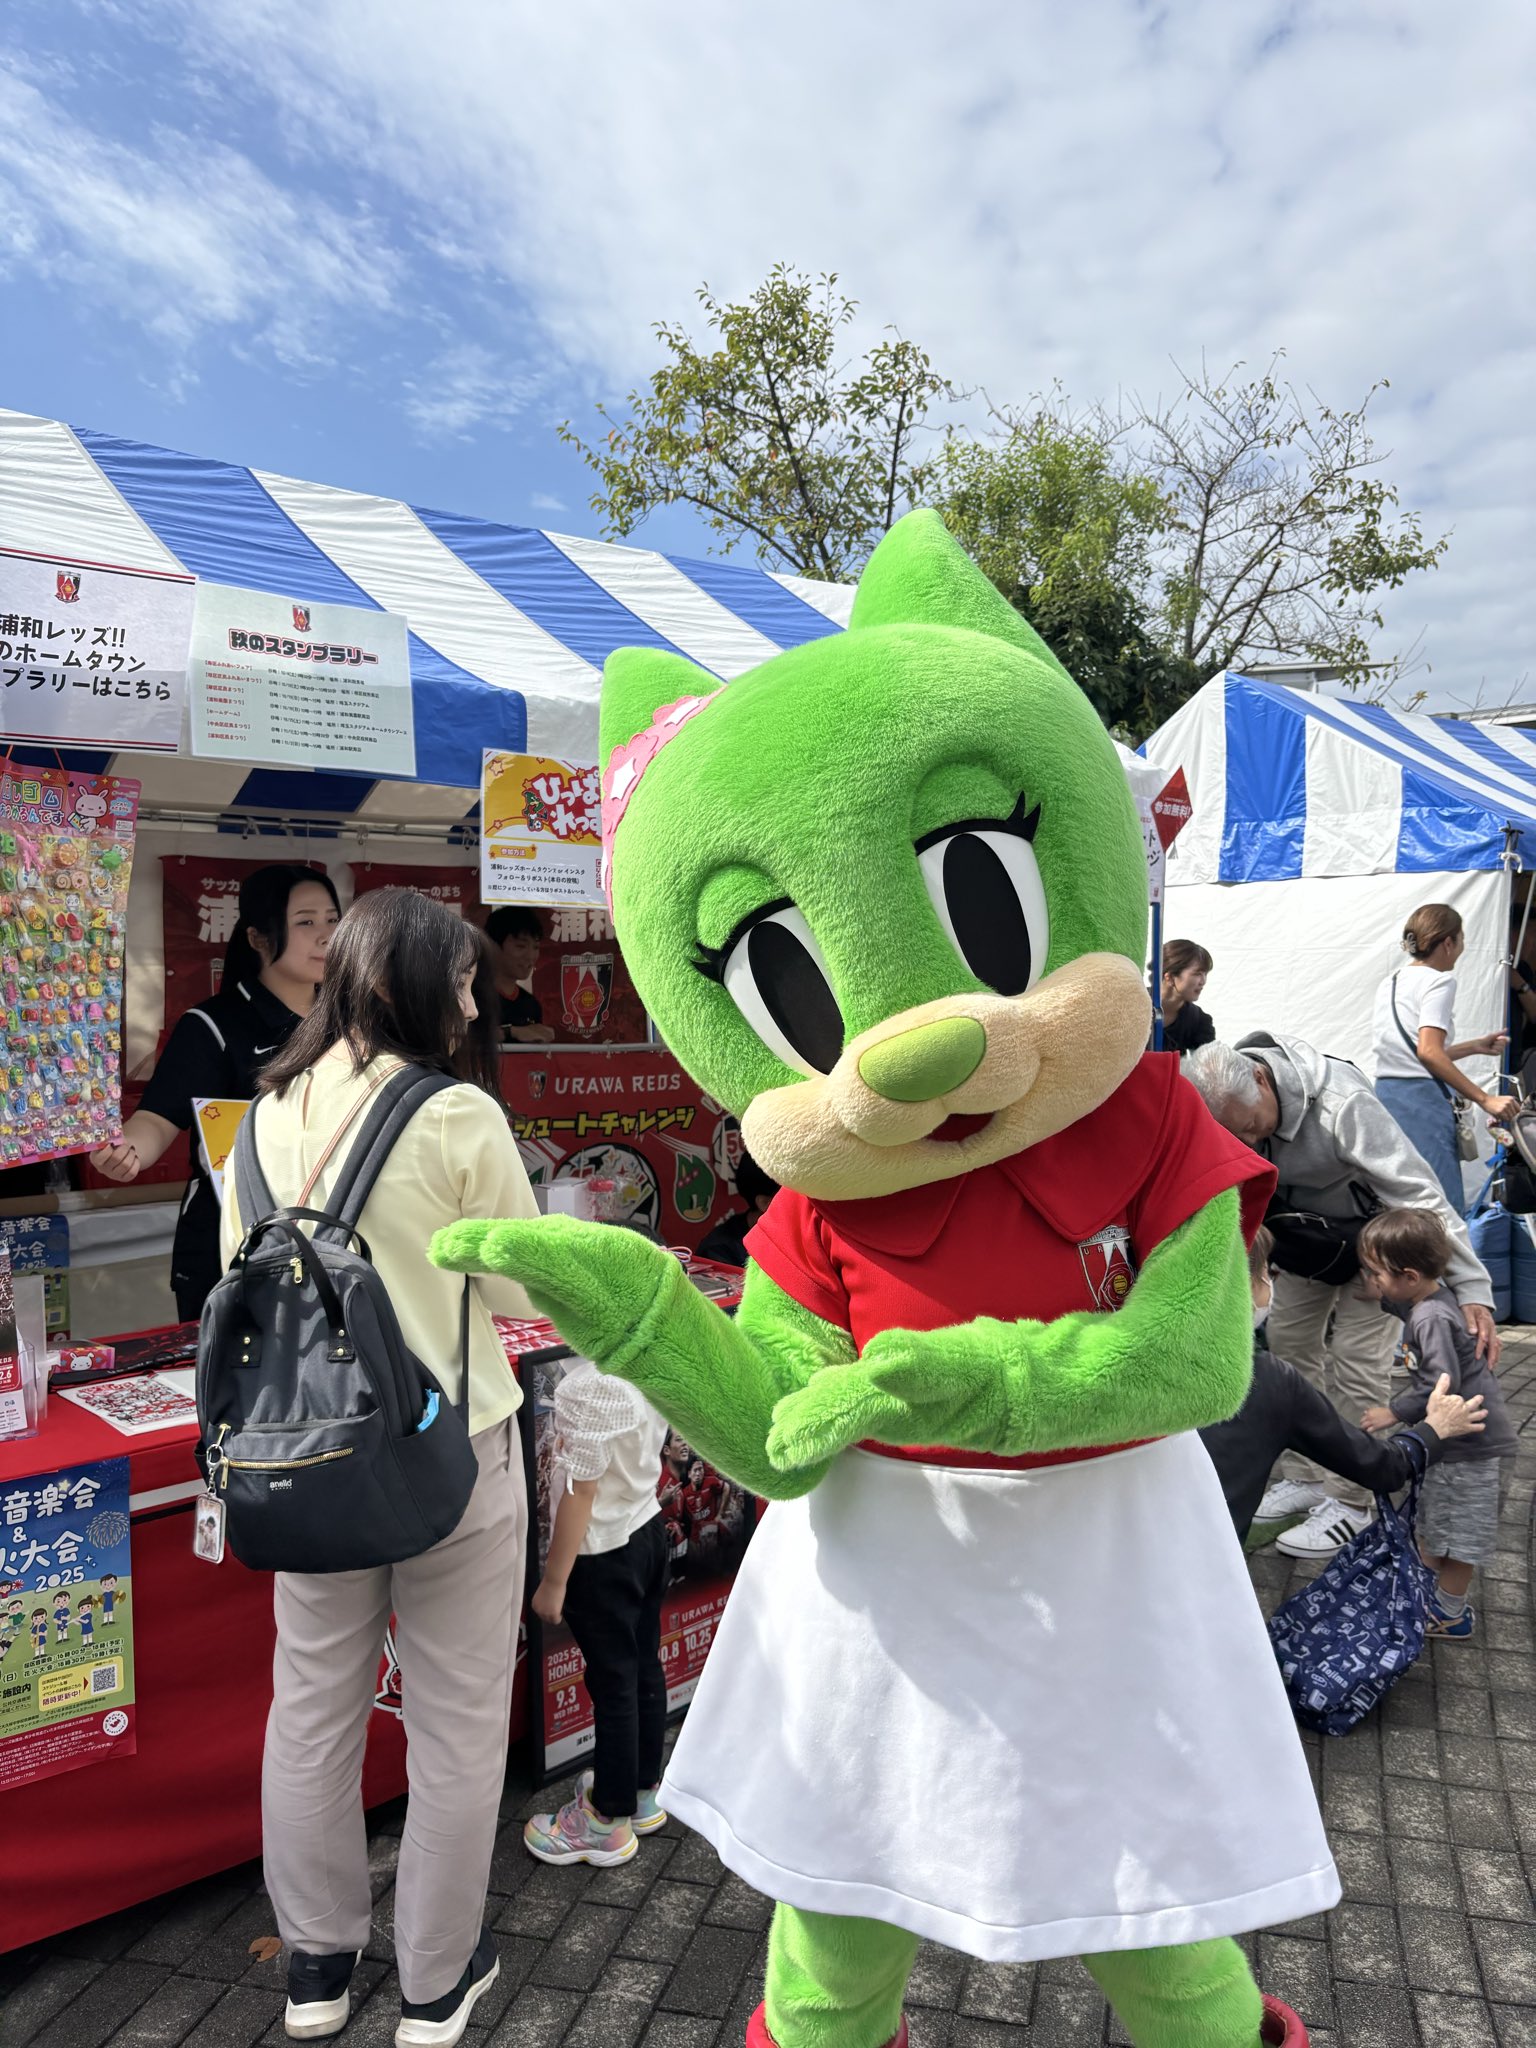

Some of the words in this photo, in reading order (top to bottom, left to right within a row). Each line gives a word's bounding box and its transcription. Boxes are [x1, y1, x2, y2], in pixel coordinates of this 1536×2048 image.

[0, 613, 126, 648] 浦和レッズ!!
[0, 640, 146, 674] のホームタウン
[230, 630, 378, 666] 秋のスタンプラリー
[3, 667, 171, 701] プラリーはこちら
[1155, 801, 1190, 818] 参加無料!
[555, 1076, 624, 1095] URAWA
[632, 1074, 680, 1092] REDS
[514, 1105, 696, 1140] シュートチャレンジ
[13, 1241, 46, 1260] 大会
[3, 1477, 101, 1525] 音楽会
[13, 1527, 27, 1543] &
[35, 1566, 85, 1593] 2025
[682, 1602, 714, 1622] URAWA
[685, 1627, 711, 1653] 10.25
[548, 1649, 569, 1667] 2025
[549, 1659, 579, 1681] HOME
[556, 1685, 576, 1709] 9.3
